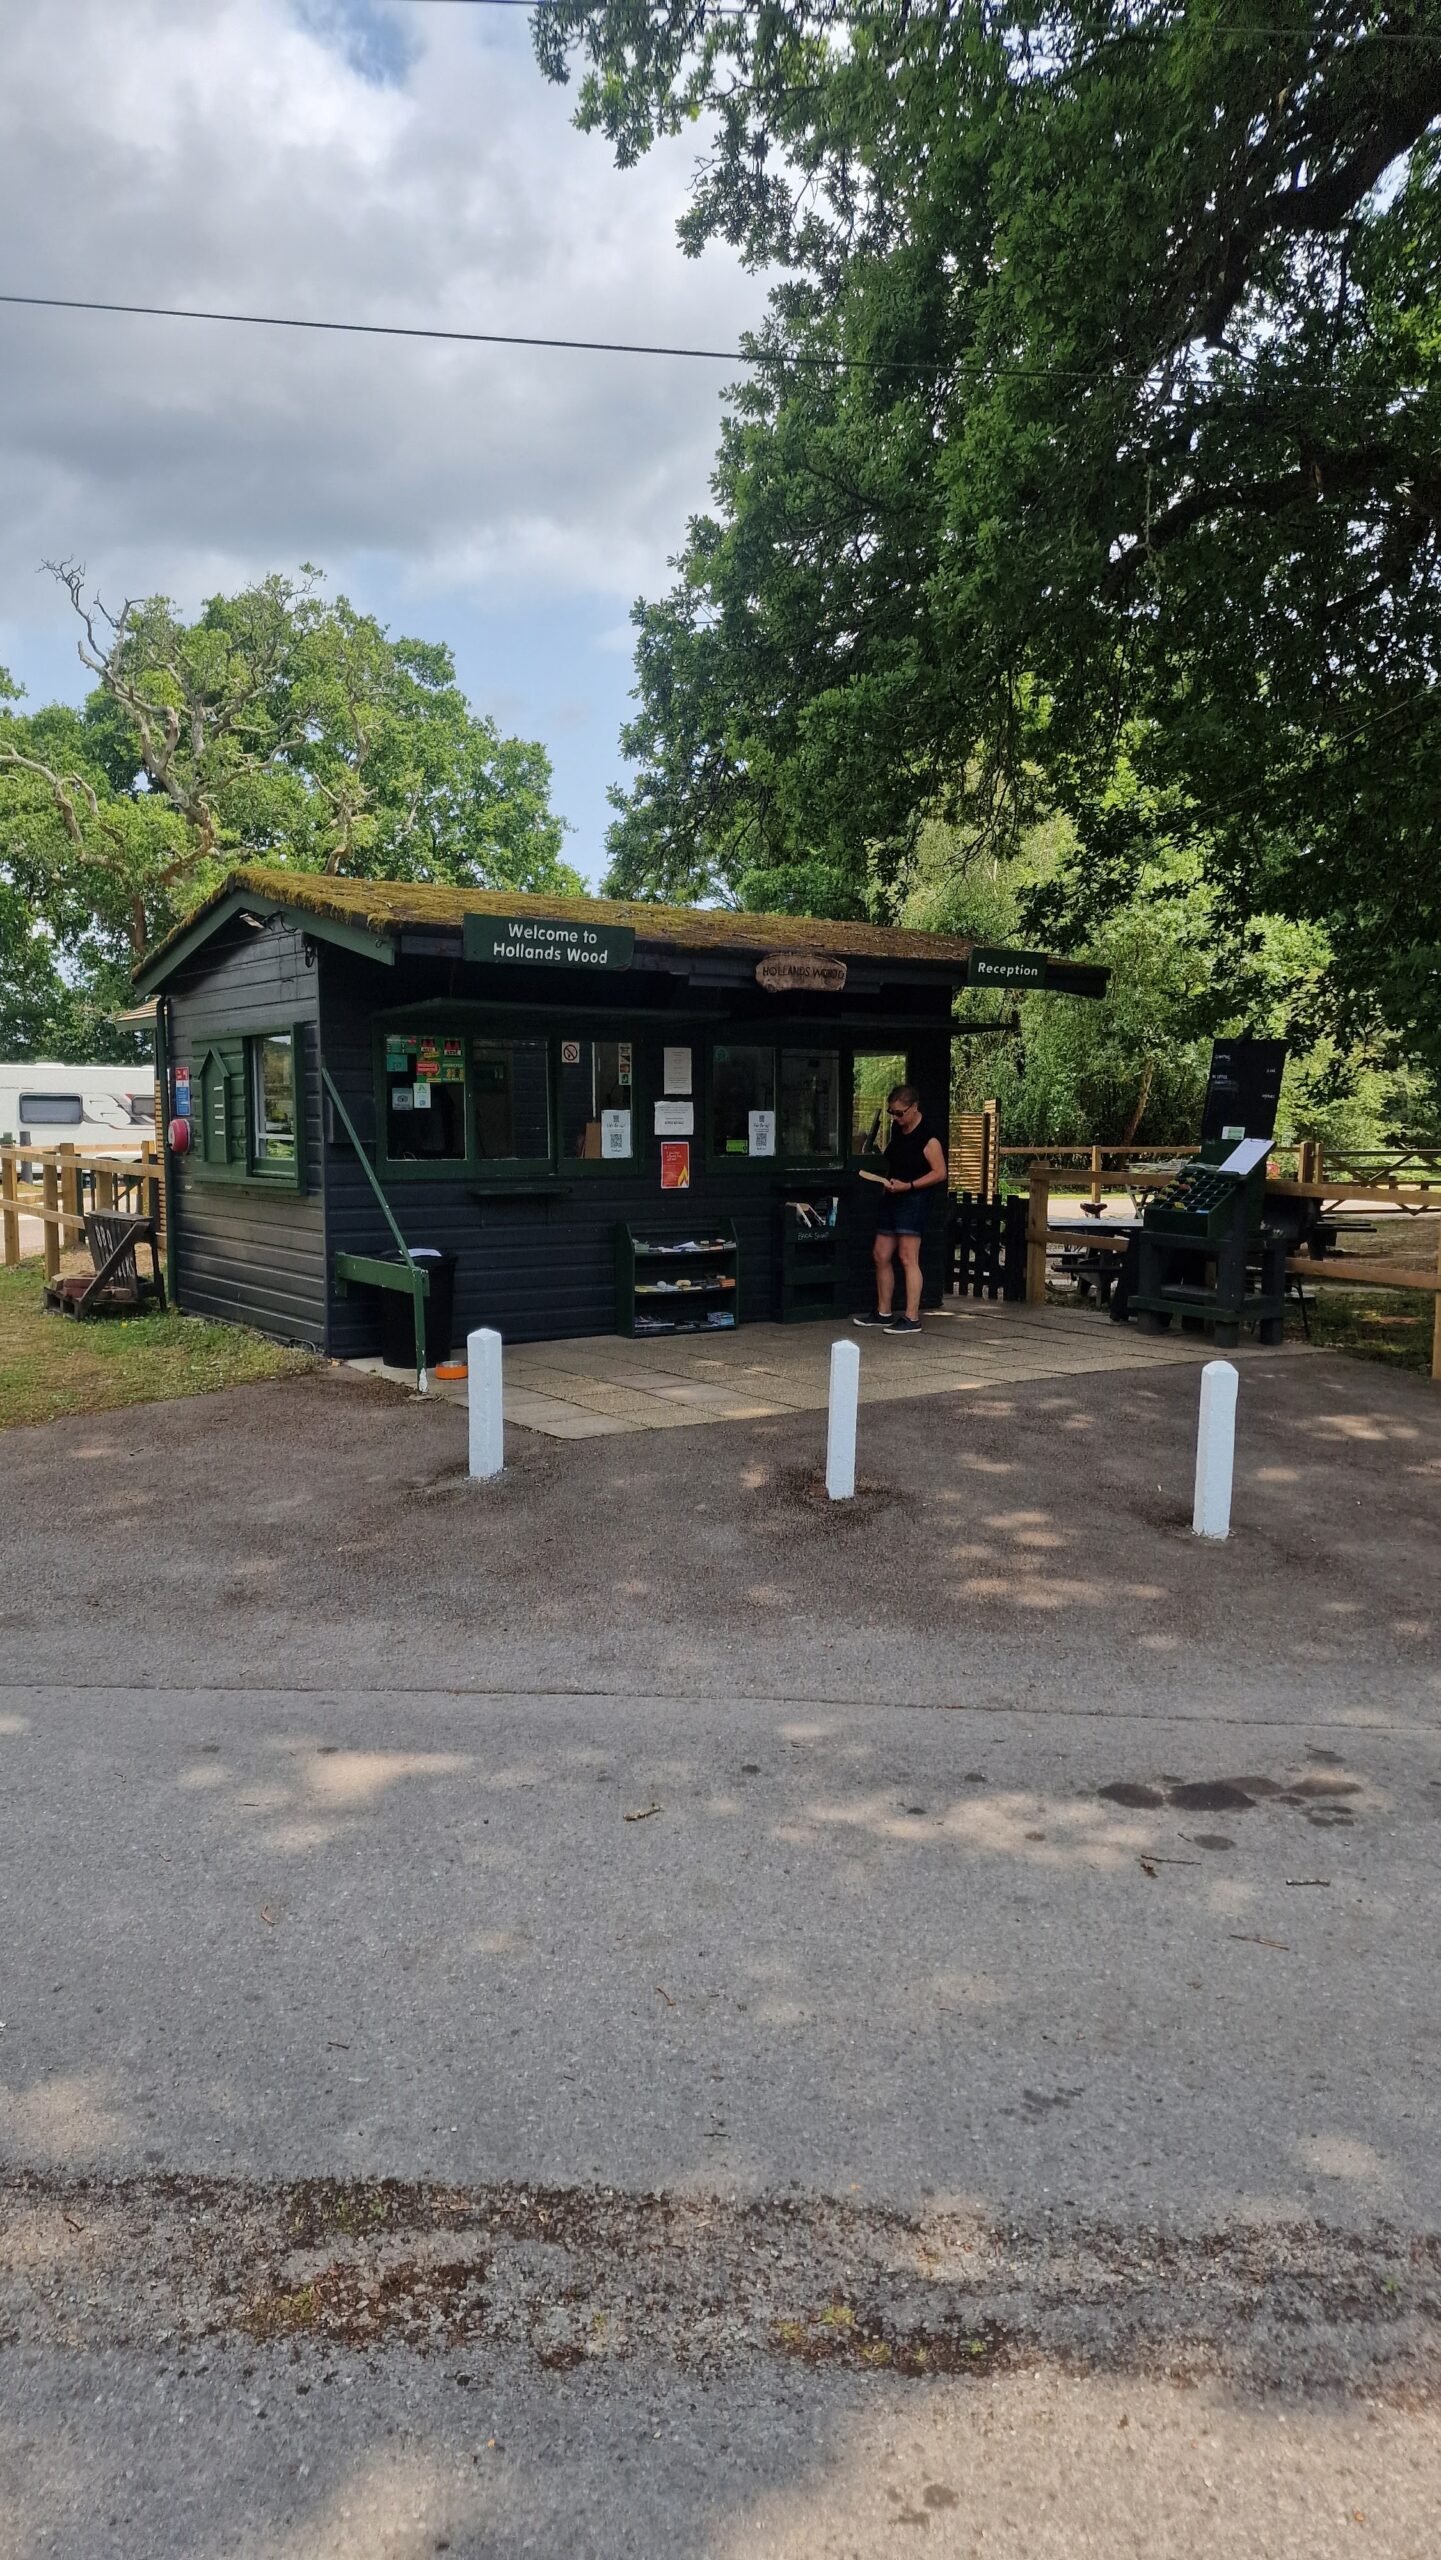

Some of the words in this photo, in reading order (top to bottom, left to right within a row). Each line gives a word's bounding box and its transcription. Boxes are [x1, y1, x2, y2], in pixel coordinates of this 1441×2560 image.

[508, 923, 578, 943] Welcome
[583, 930, 598, 944] to
[493, 942, 561, 961] Hollands
[567, 948, 608, 964] Wood
[762, 965, 811, 977] HOLLANDS
[813, 967, 844, 979] WOOD
[977, 962, 1039, 977] Reception
[95, 1224, 114, 1252] BBQ
